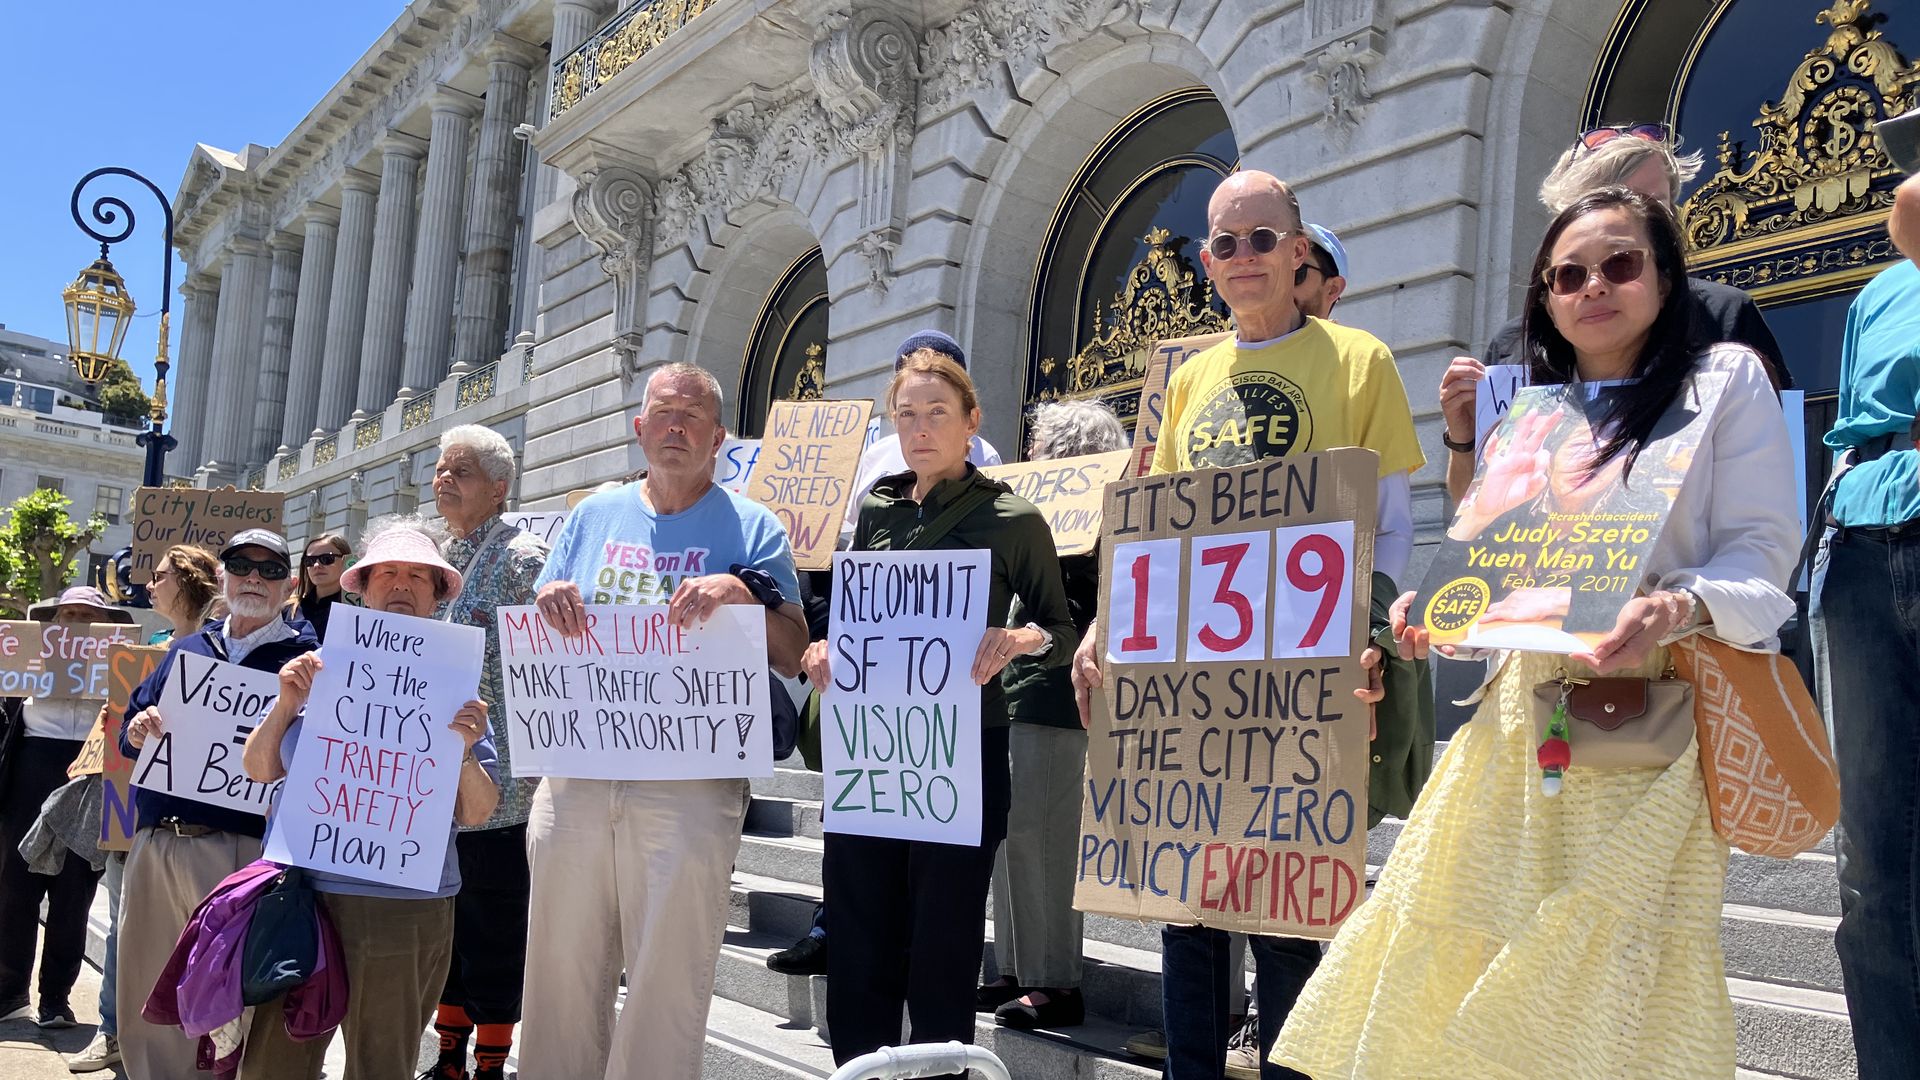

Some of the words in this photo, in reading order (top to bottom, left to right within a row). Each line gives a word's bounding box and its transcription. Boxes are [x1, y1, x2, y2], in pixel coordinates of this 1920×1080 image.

[1204, 387, 1287, 418] FAMILIES
[1267, 376, 1288, 393] BAY
[1288, 389, 1305, 413] AREA
[774, 405, 806, 439] WE
[807, 404, 862, 439] NEED
[1192, 414, 1292, 452] SAFE
[775, 443, 833, 474] SAFE
[141, 494, 195, 528] City
[203, 493, 279, 523] leaders:
[760, 474, 846, 507] STREETS
[1113, 476, 1197, 536] IT'S
[1210, 456, 1319, 526] BEEN
[136, 519, 177, 542] Our
[182, 520, 226, 546] lives
[1493, 521, 1561, 548] Judy
[1567, 521, 1650, 544] Szeto
[1547, 511, 1659, 523] #crashnotaccident
[605, 543, 651, 570] YES
[653, 555, 681, 573] on
[684, 550, 706, 573] K
[1467, 546, 1528, 568] Yuen
[1534, 547, 1595, 569] Man
[1605, 547, 1639, 571] Yu
[597, 566, 700, 596] OCEA
[839, 558, 978, 624] RECOMMIT
[1501, 573, 1536, 589] Feb
[1541, 574, 1571, 589] 22
[1578, 574, 1629, 592] 2011
[1433, 598, 1481, 616] SAFE
[354, 614, 425, 657] Where
[386, 665, 428, 700] the
[508, 662, 574, 700] MAKE
[577, 662, 661, 705] TRAFFIC
[672, 665, 757, 707] SAFETY
[834, 633, 884, 695] SF
[898, 636, 952, 697] TO
[1114, 670, 1213, 722] DAYS
[1223, 666, 1344, 723] SINCE
[335, 695, 431, 753] CITY'S
[515, 709, 587, 751] YOUR
[832, 702, 958, 771] VISION
[138, 731, 173, 792] A
[317, 735, 436, 796] TRAFFIC
[1108, 727, 1183, 772] THE
[1198, 725, 1322, 786] CITY'S
[307, 776, 424, 836] SAFETY
[831, 768, 959, 824] ZERO
[1088, 777, 1223, 837] VISION
[1243, 784, 1356, 847] ZERO
[1078, 833, 1203, 904] POLICY
[1199, 842, 1358, 928] EXPIRED
